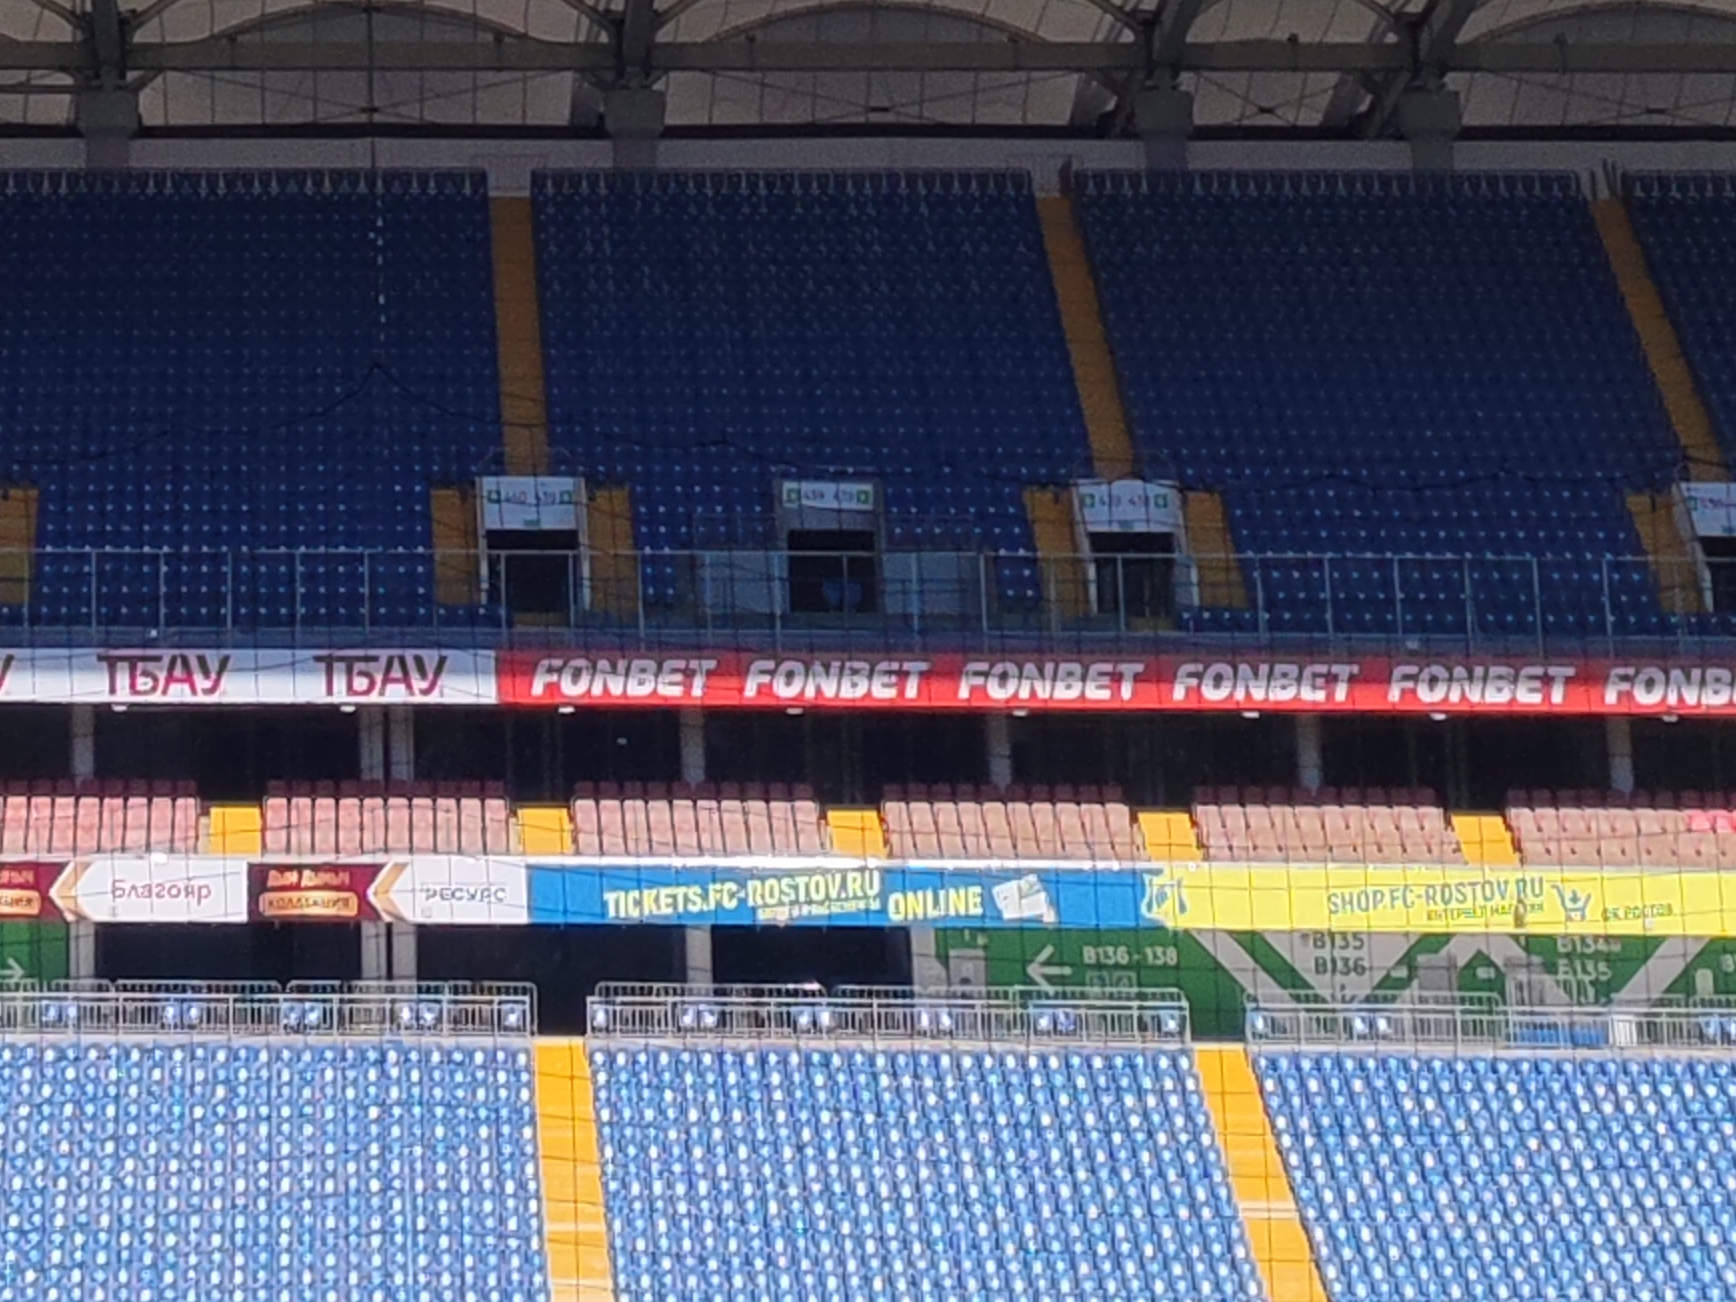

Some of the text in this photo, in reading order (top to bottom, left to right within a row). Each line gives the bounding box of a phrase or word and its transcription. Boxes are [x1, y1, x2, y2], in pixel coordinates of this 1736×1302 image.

[532, 658, 717, 699] FONBET
[743, 659, 931, 700] FONBET
[957, 660, 1145, 701] FONBET
[1172, 662, 1359, 703] FONBET
[1386, 664, 1576, 704] FONBET
[602, 869, 881, 920] TICKETS.FC-ROSTOV.RU
[887, 884, 983, 922] ONLINE
[1328, 876, 1544, 916] SHOP.FC-ROSTOV.RU
[1314, 955, 1366, 976] B136
